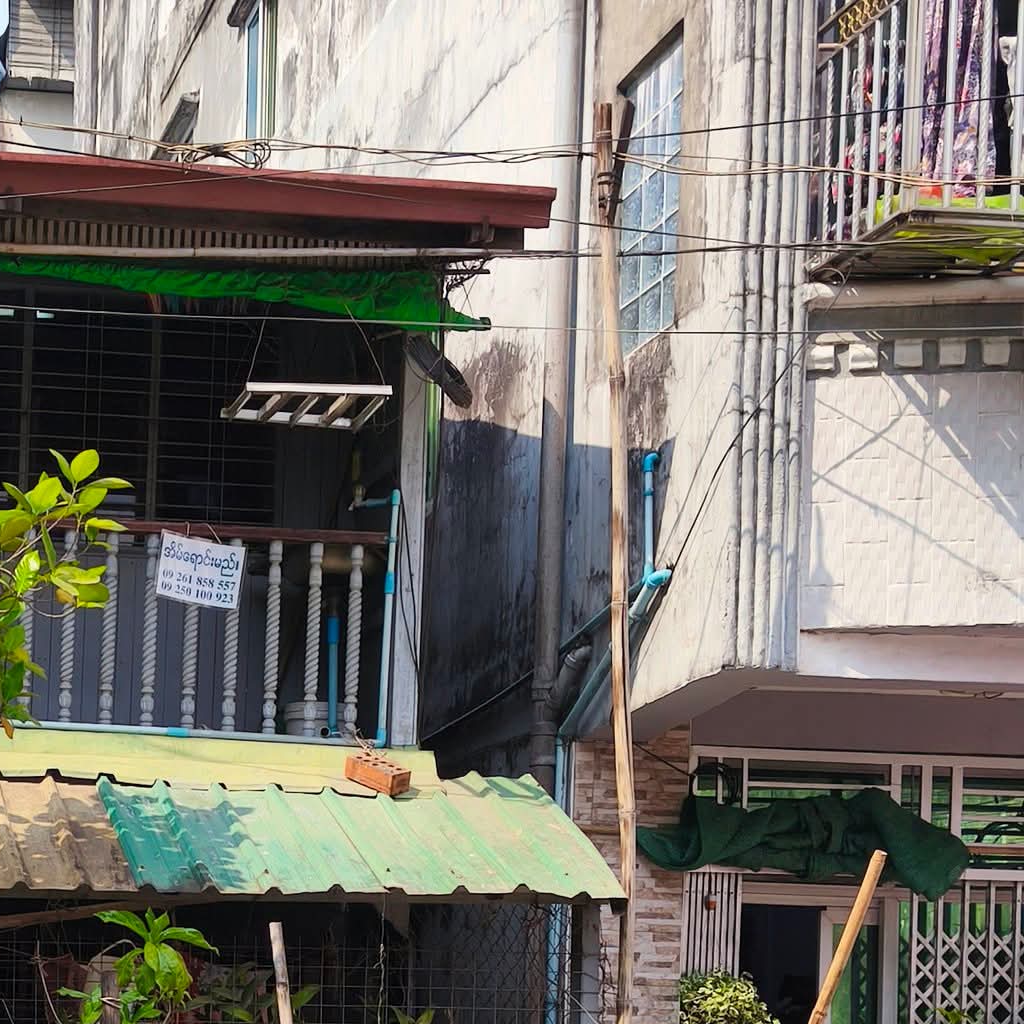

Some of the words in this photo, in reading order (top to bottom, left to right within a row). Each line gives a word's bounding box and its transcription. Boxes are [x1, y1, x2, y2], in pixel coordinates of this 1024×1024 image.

[162, 569, 174, 579] 09
[176, 572, 193, 584] 261
[196, 576, 215, 588] 858
[217, 580, 236, 591] 557
[161, 582, 173, 591] 09
[175, 584, 192, 596] 250
[196, 589, 213, 600] 100
[215, 593, 234, 604] 923
